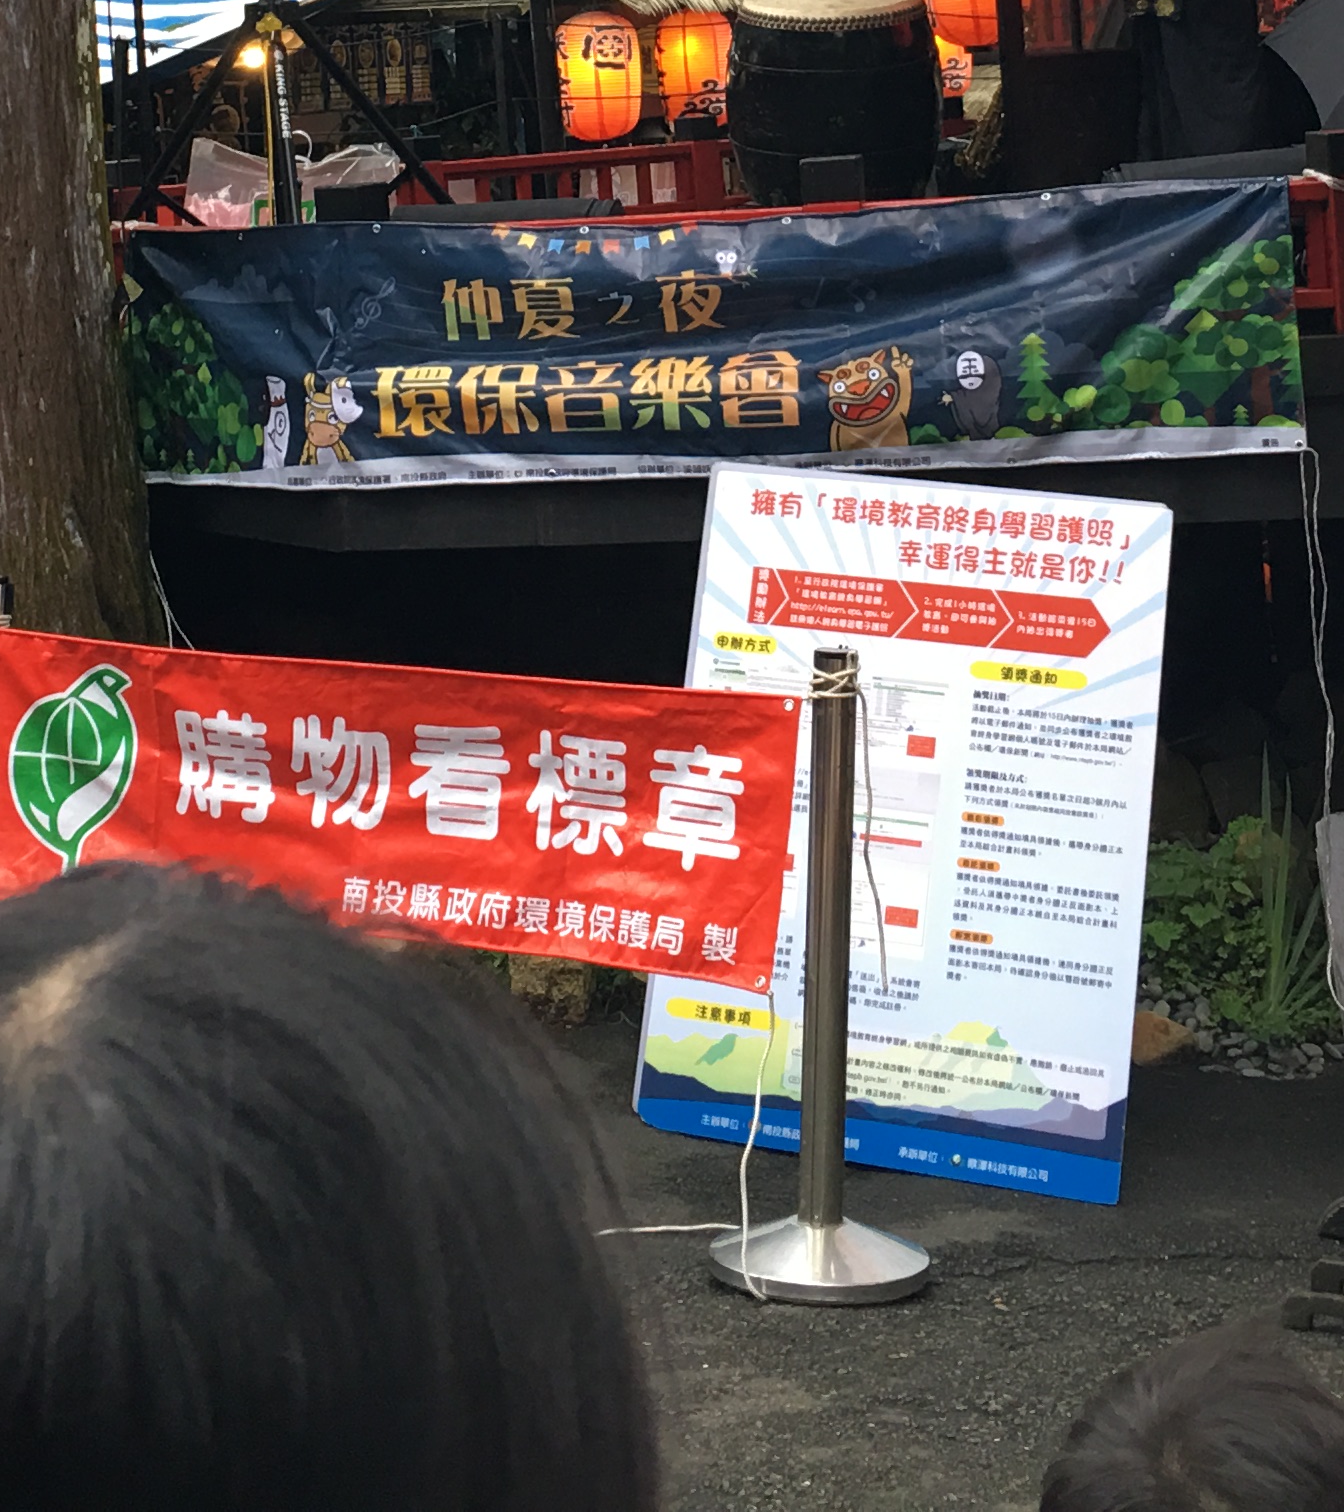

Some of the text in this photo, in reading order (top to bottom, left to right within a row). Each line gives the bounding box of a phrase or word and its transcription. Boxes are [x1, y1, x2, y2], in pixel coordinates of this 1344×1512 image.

[275, 64, 292, 138] KING STAGE
[442, 269, 728, 341] 仲夏之夜
[374, 350, 801, 439] 環保音樂會
[751, 489, 1130, 550] 擁有「環境教育終身學習護照」
[716, 635, 771, 654] 申辦方式
[1001, 666, 1058, 685] 領獎通知
[174, 708, 744, 871] 購物看標章
[342, 876, 685, 956] 南投縣政府環境保護局
[703, 923, 738, 965] 製
[695, 1004, 751, 1025] 注意事項
